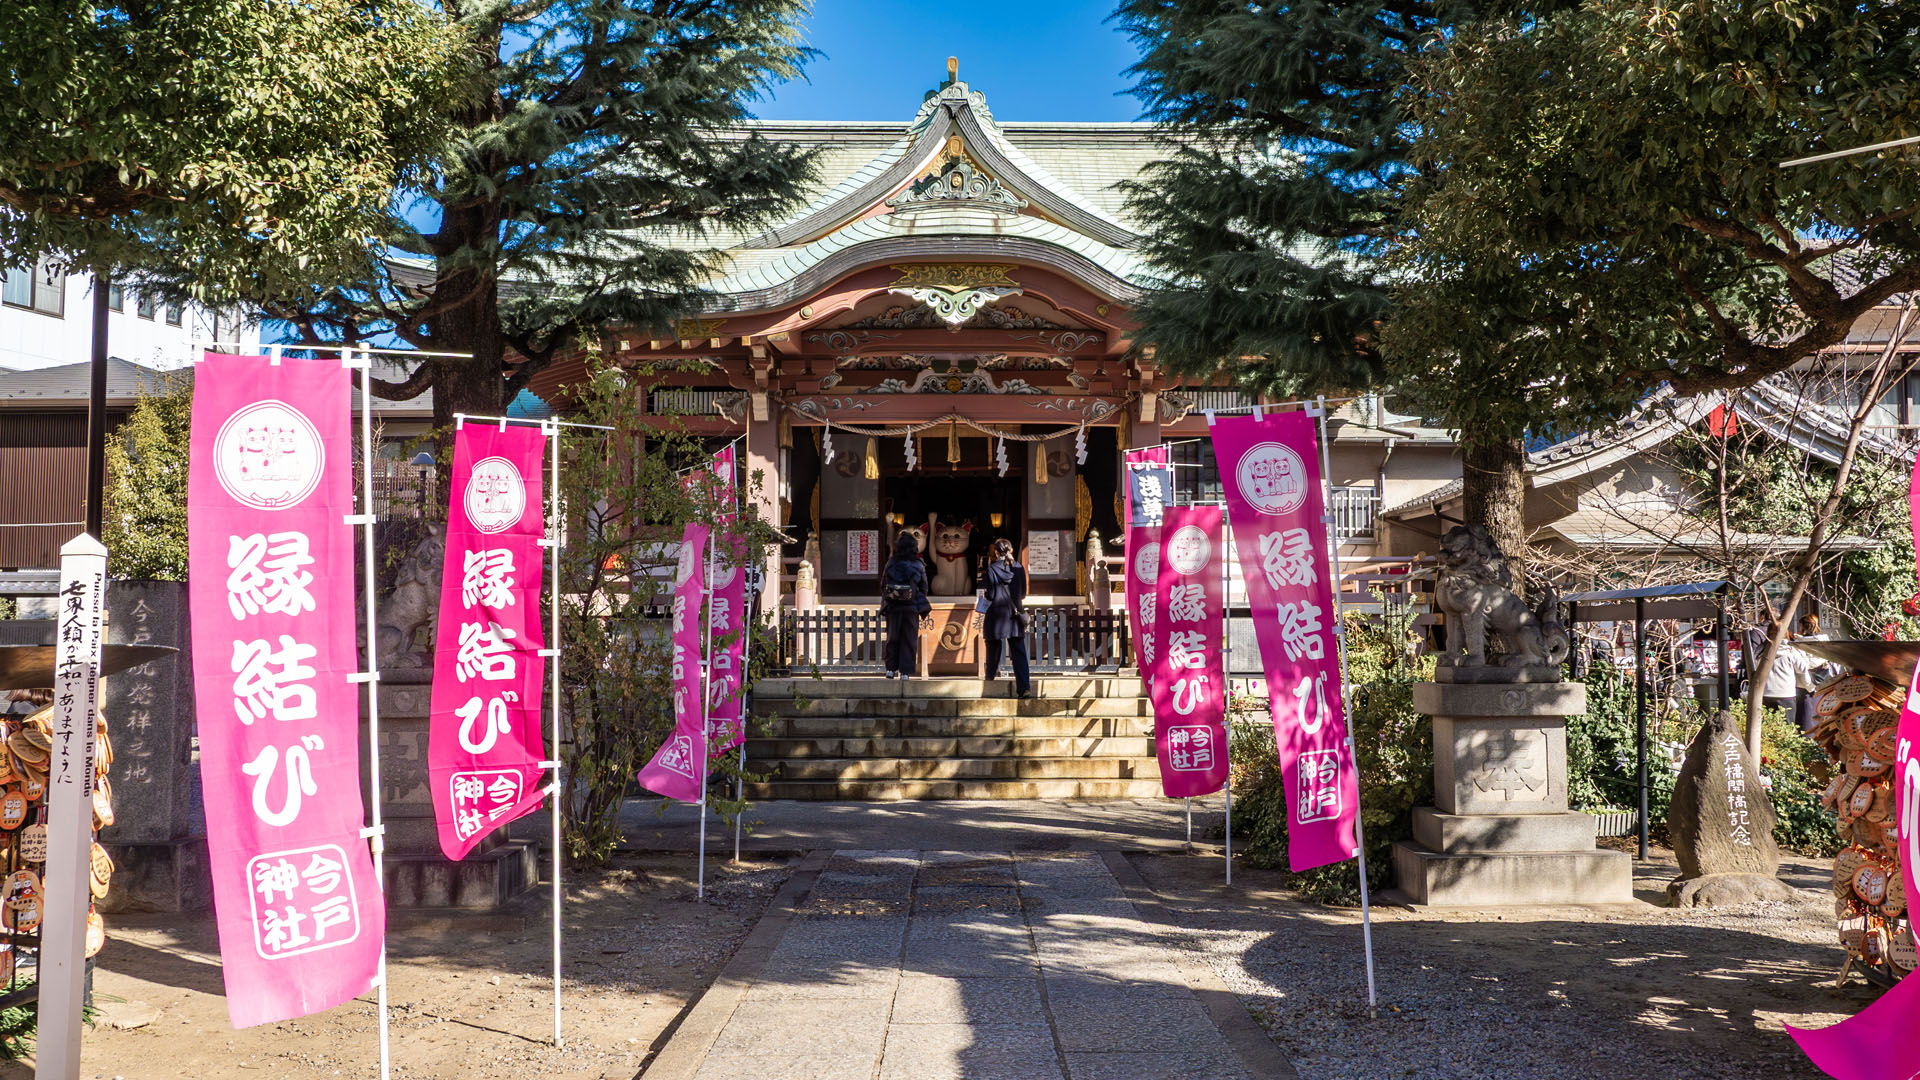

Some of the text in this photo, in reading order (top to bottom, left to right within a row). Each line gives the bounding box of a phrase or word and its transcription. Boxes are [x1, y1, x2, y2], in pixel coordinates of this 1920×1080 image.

[92, 572, 102, 614] Puisse
[92, 617, 100, 627] la
[90, 630, 99, 657] Paix
[455, 549, 518, 754] 縁結び
[1169, 584, 1207, 716] 縁結び
[1259, 527, 1328, 735] 縁結び
[57, 580, 87, 784] 世界人類が平和でありますように
[226, 530, 324, 827] 縁結び
[85, 742, 94, 753] le
[86, 709, 96, 738] dans
[1172, 730, 1190, 770] 神社
[1191, 729, 1213, 768] 今戸
[83, 756, 93, 798] Monde
[1300, 758, 1317, 817] 神社
[1317, 755, 1338, 814] 今戸
[1720, 733, 1751, 846] 今戸橋開橋記念
[455, 777, 485, 837] 神社
[255, 860, 308, 952] 神社
[302, 854, 350, 942] 今戸
